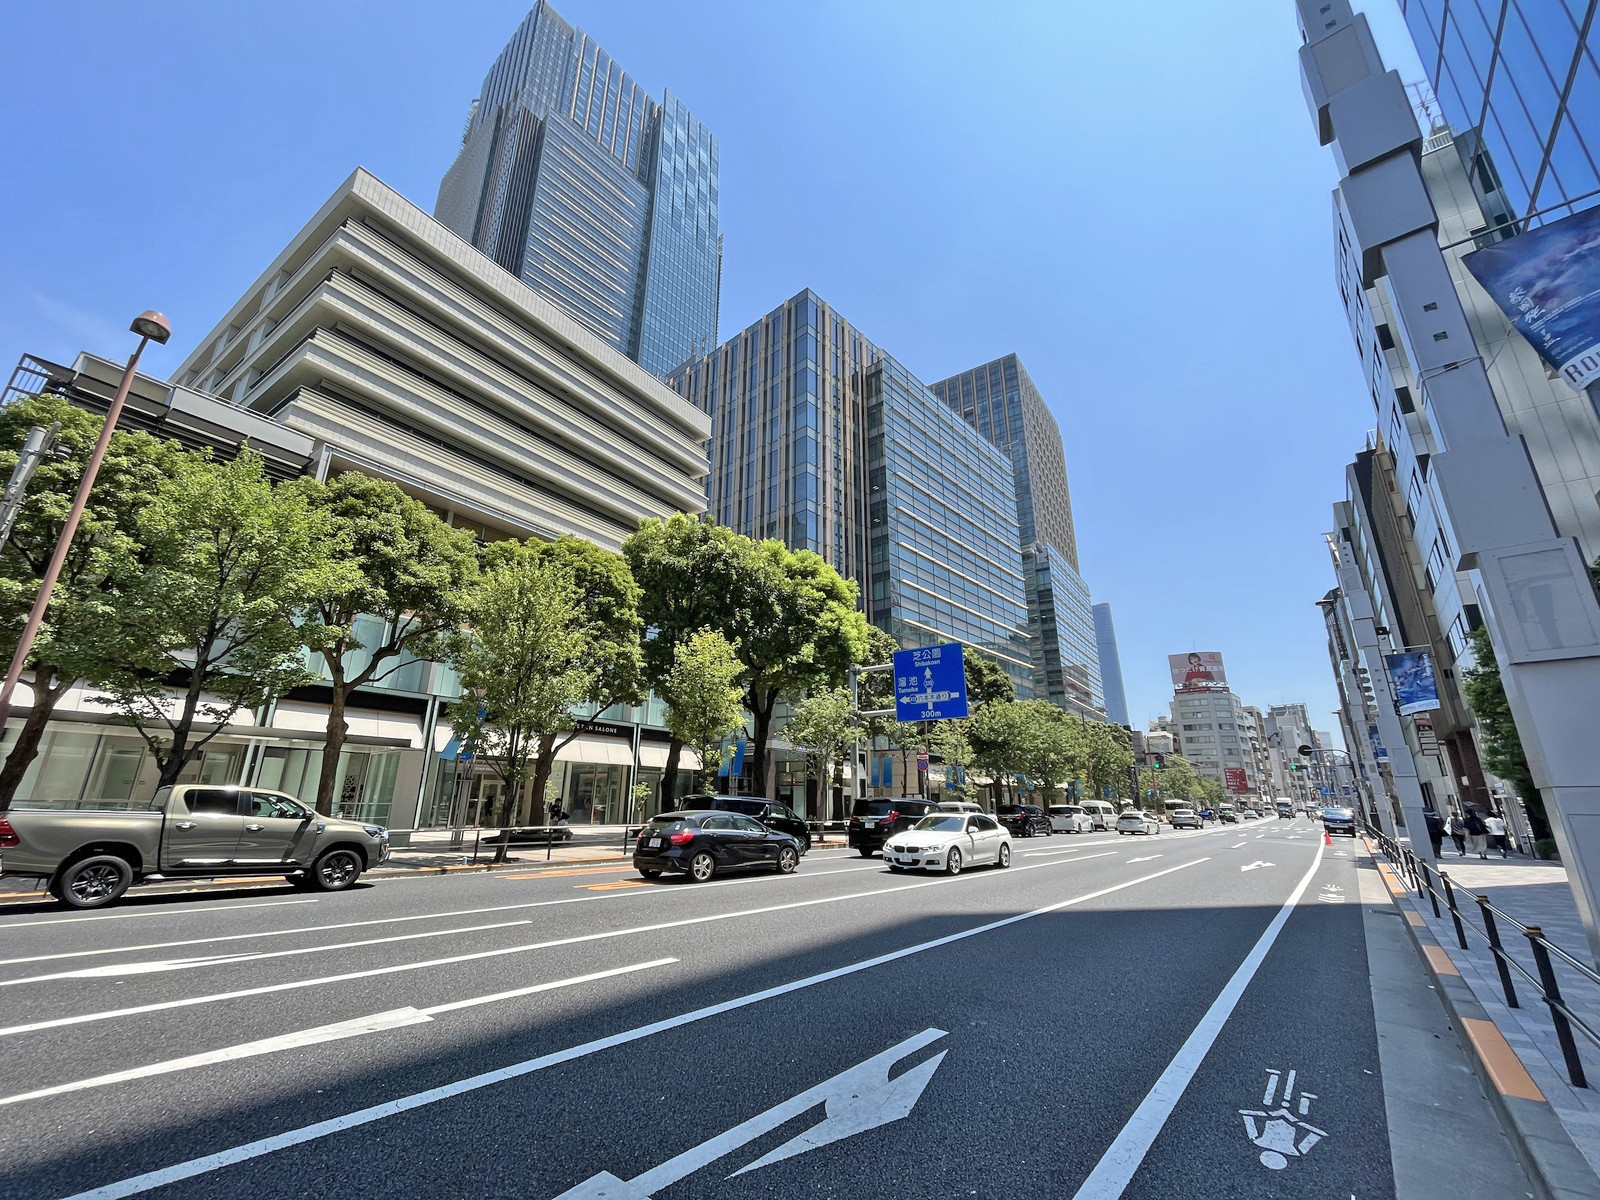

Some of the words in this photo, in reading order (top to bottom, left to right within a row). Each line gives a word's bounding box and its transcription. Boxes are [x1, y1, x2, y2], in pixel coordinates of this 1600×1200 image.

[1564, 351, 1600, 383] RO
[921, 710, 941, 718] 300m
[594, 725, 617, 733] SALONE
